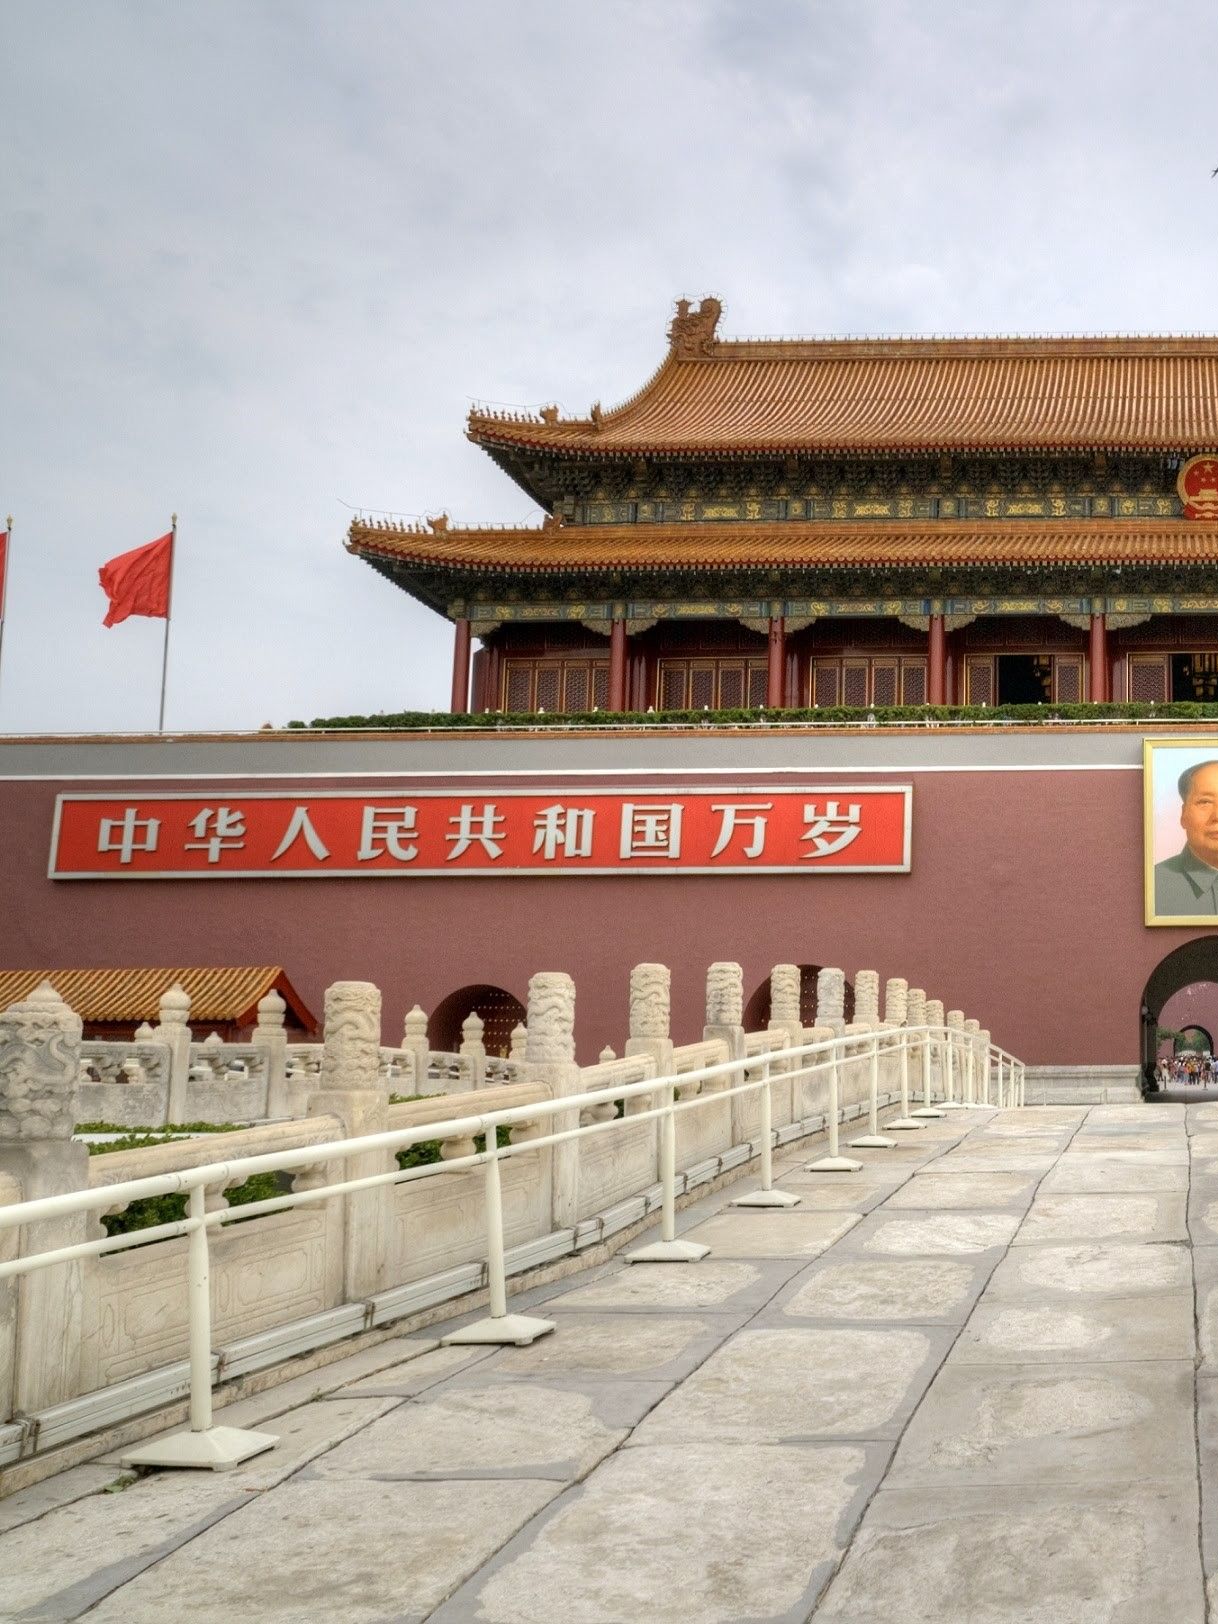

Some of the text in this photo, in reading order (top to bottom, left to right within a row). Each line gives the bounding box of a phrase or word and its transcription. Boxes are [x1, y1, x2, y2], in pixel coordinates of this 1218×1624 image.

[97, 800, 864, 865] 中华人民共和国万岁
